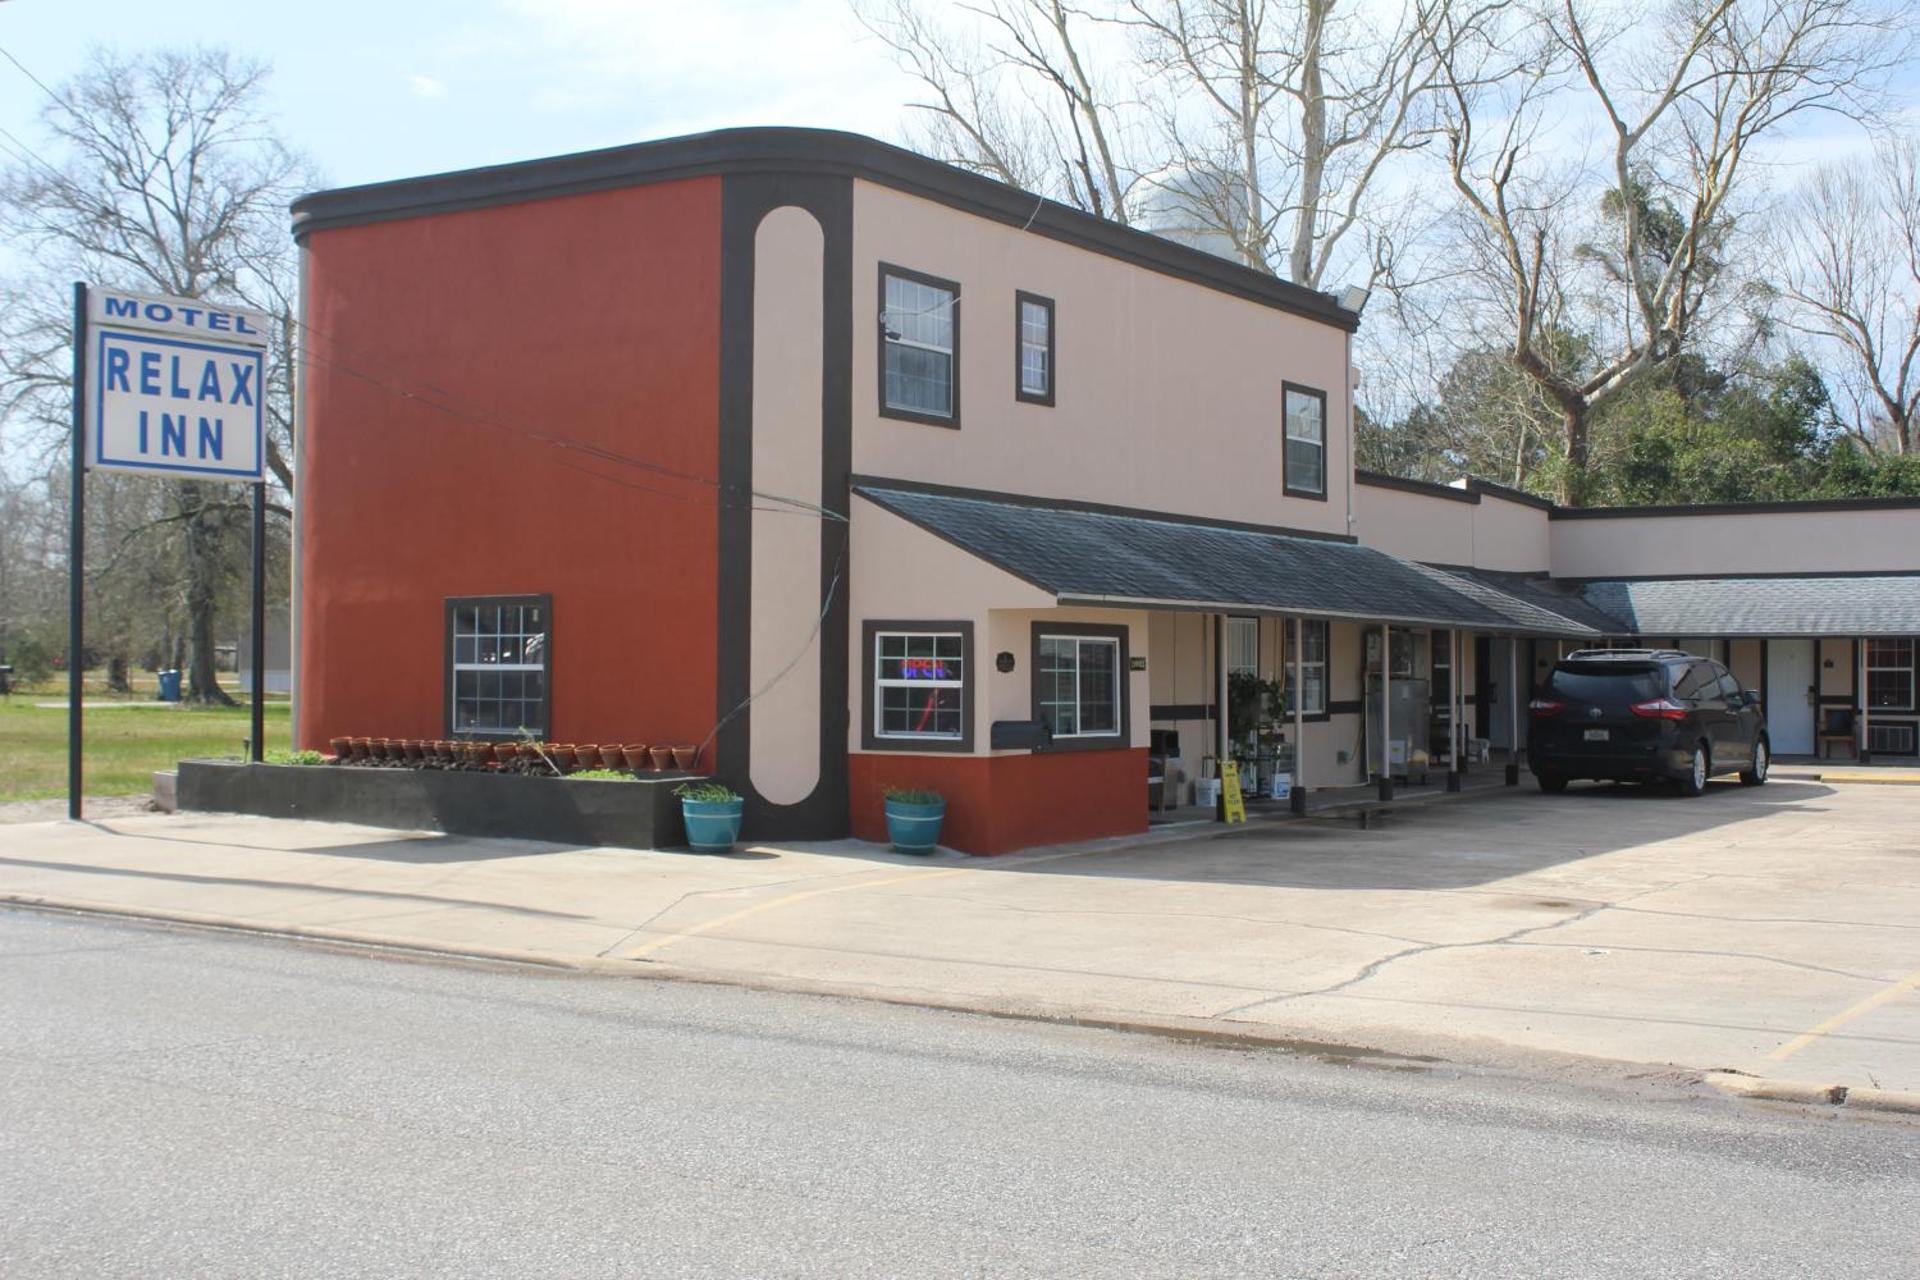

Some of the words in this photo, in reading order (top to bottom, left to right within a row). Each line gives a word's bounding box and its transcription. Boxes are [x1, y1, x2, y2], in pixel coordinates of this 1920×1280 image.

[105, 297, 257, 335] MOTEL
[107, 347, 254, 407] RELAX
[140, 411, 223, 461] INN
